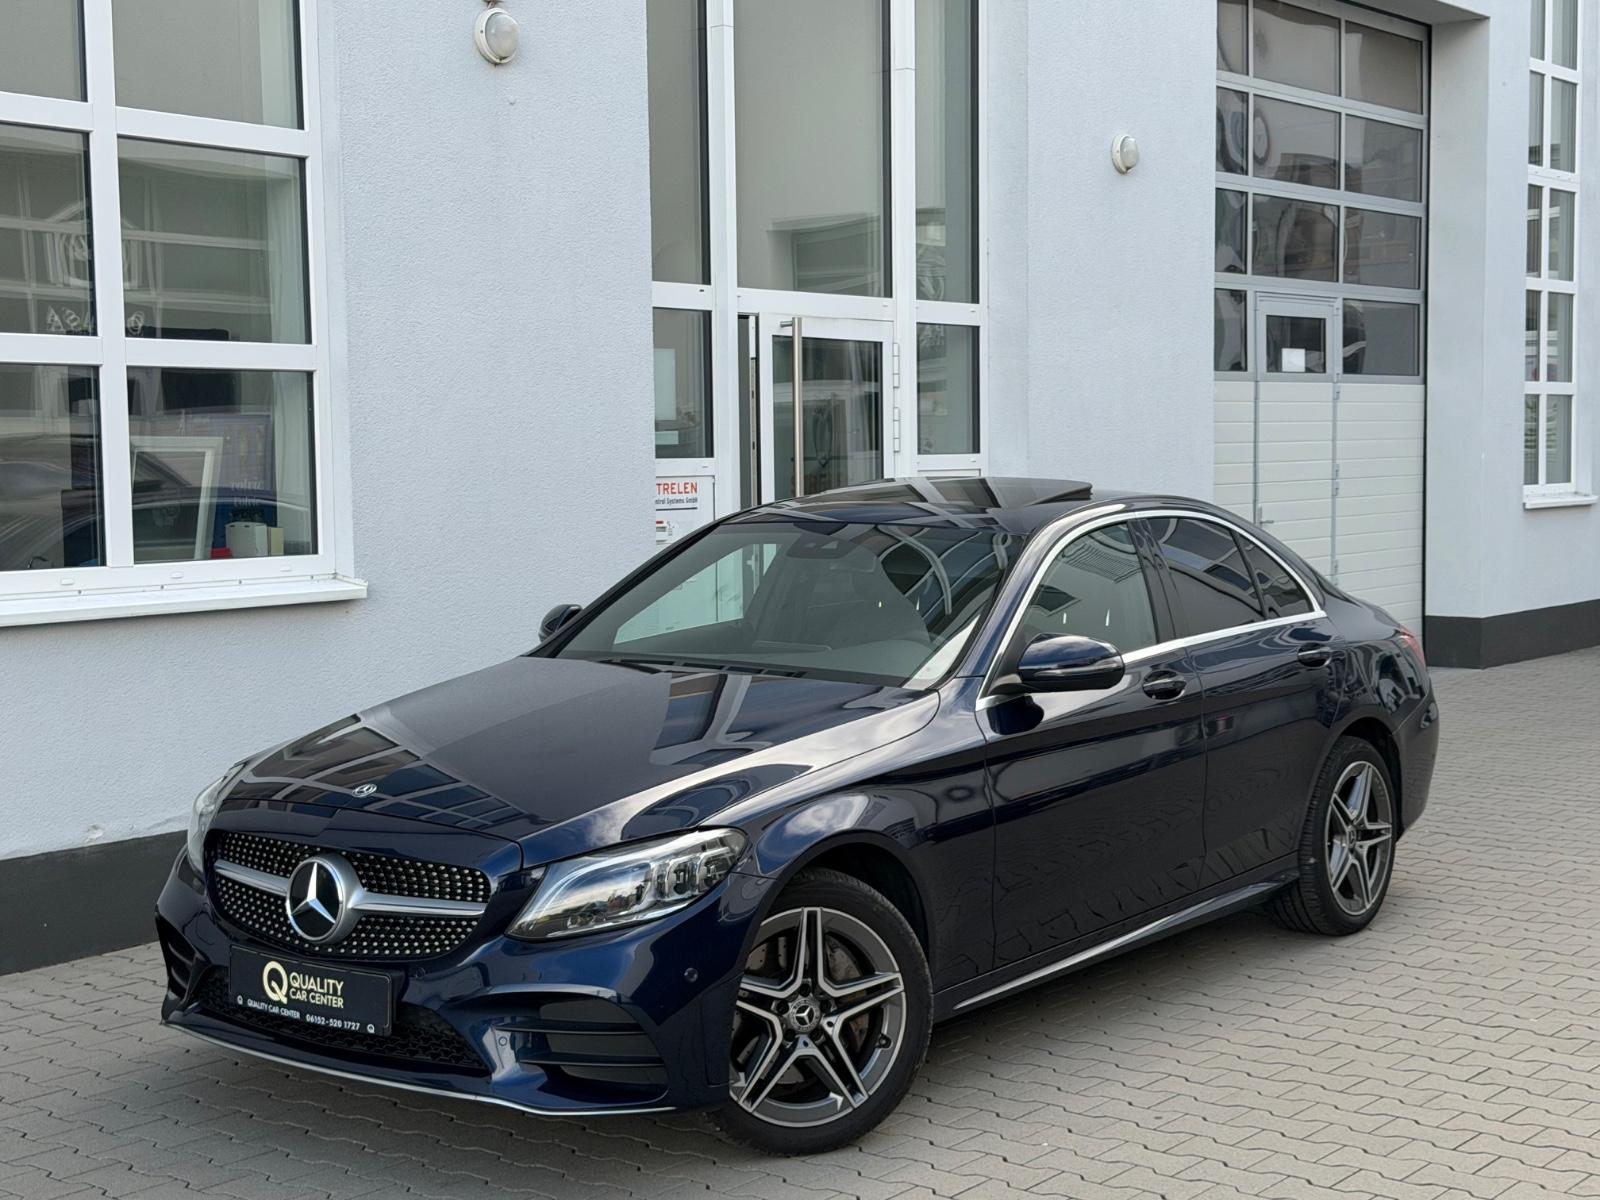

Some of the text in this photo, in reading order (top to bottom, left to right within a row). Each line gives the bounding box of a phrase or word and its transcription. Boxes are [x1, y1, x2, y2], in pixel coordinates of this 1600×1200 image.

[656, 482, 698, 495] TRELEN
[666, 497, 685, 506] Systems
[686, 496, 698, 504] GmbH
[289, 972, 344, 996] QUALITY
[290, 988, 344, 1008] CAR CENTER
[247, 999, 300, 1019] QUALITY CAR CENTER
[344, 1021, 360, 1030] 1727
